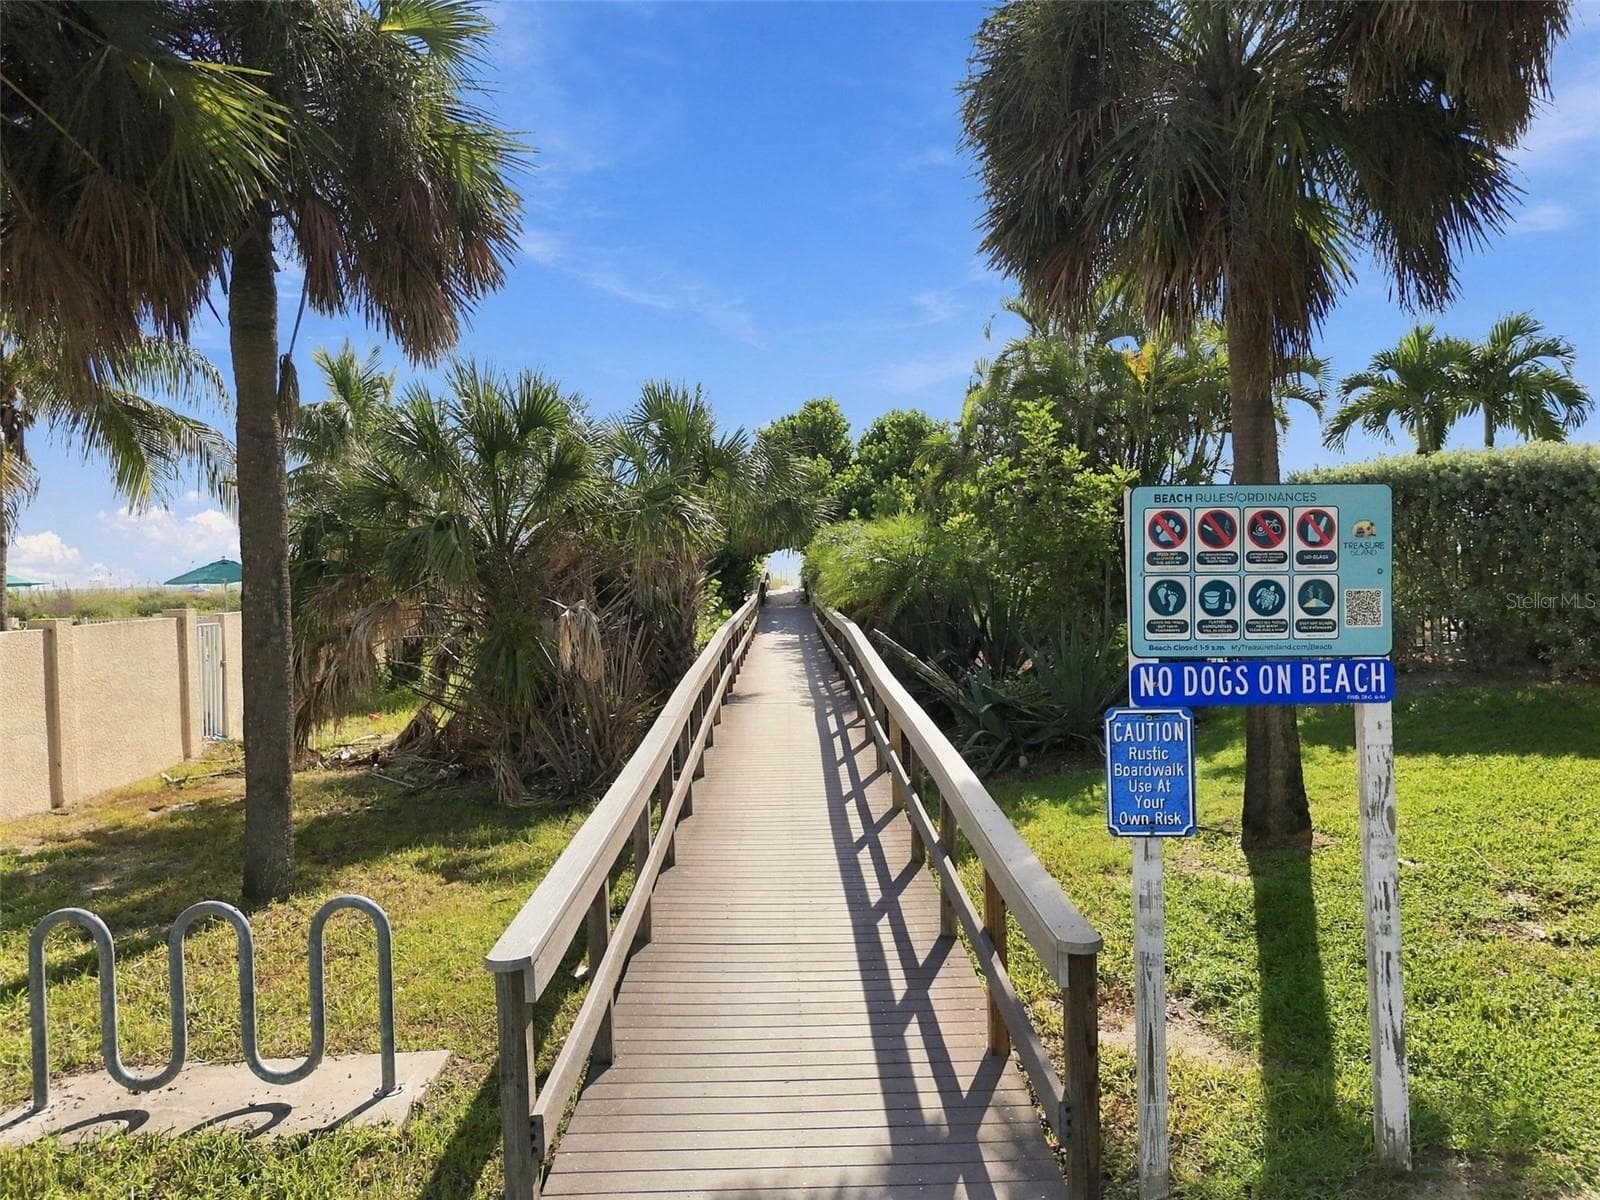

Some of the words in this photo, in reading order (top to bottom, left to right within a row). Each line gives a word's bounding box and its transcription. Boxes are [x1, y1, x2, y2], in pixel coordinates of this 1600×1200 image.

[1154, 493, 1192, 503] BEACH
[1196, 491, 1317, 503] RULES/ORDINANCES
[1343, 541, 1385, 550] TREASURE
[1173, 643, 1197, 651] Closed
[1139, 666, 1173, 697] NO
[1184, 665, 1249, 697] DOGS
[1258, 664, 1292, 695] ON
[1302, 663, 1386, 694] BEACH
[1113, 722, 1184, 742] CAUTION
[1128, 746, 1169, 760] Rustic
[1114, 763, 1184, 777] Boardwalk
[1128, 779, 1152, 792] Use
[1157, 779, 1171, 792] At
[1134, 794, 1165, 809] Your
[1119, 811, 1149, 825] Own
[1154, 811, 1182, 825] Risk
